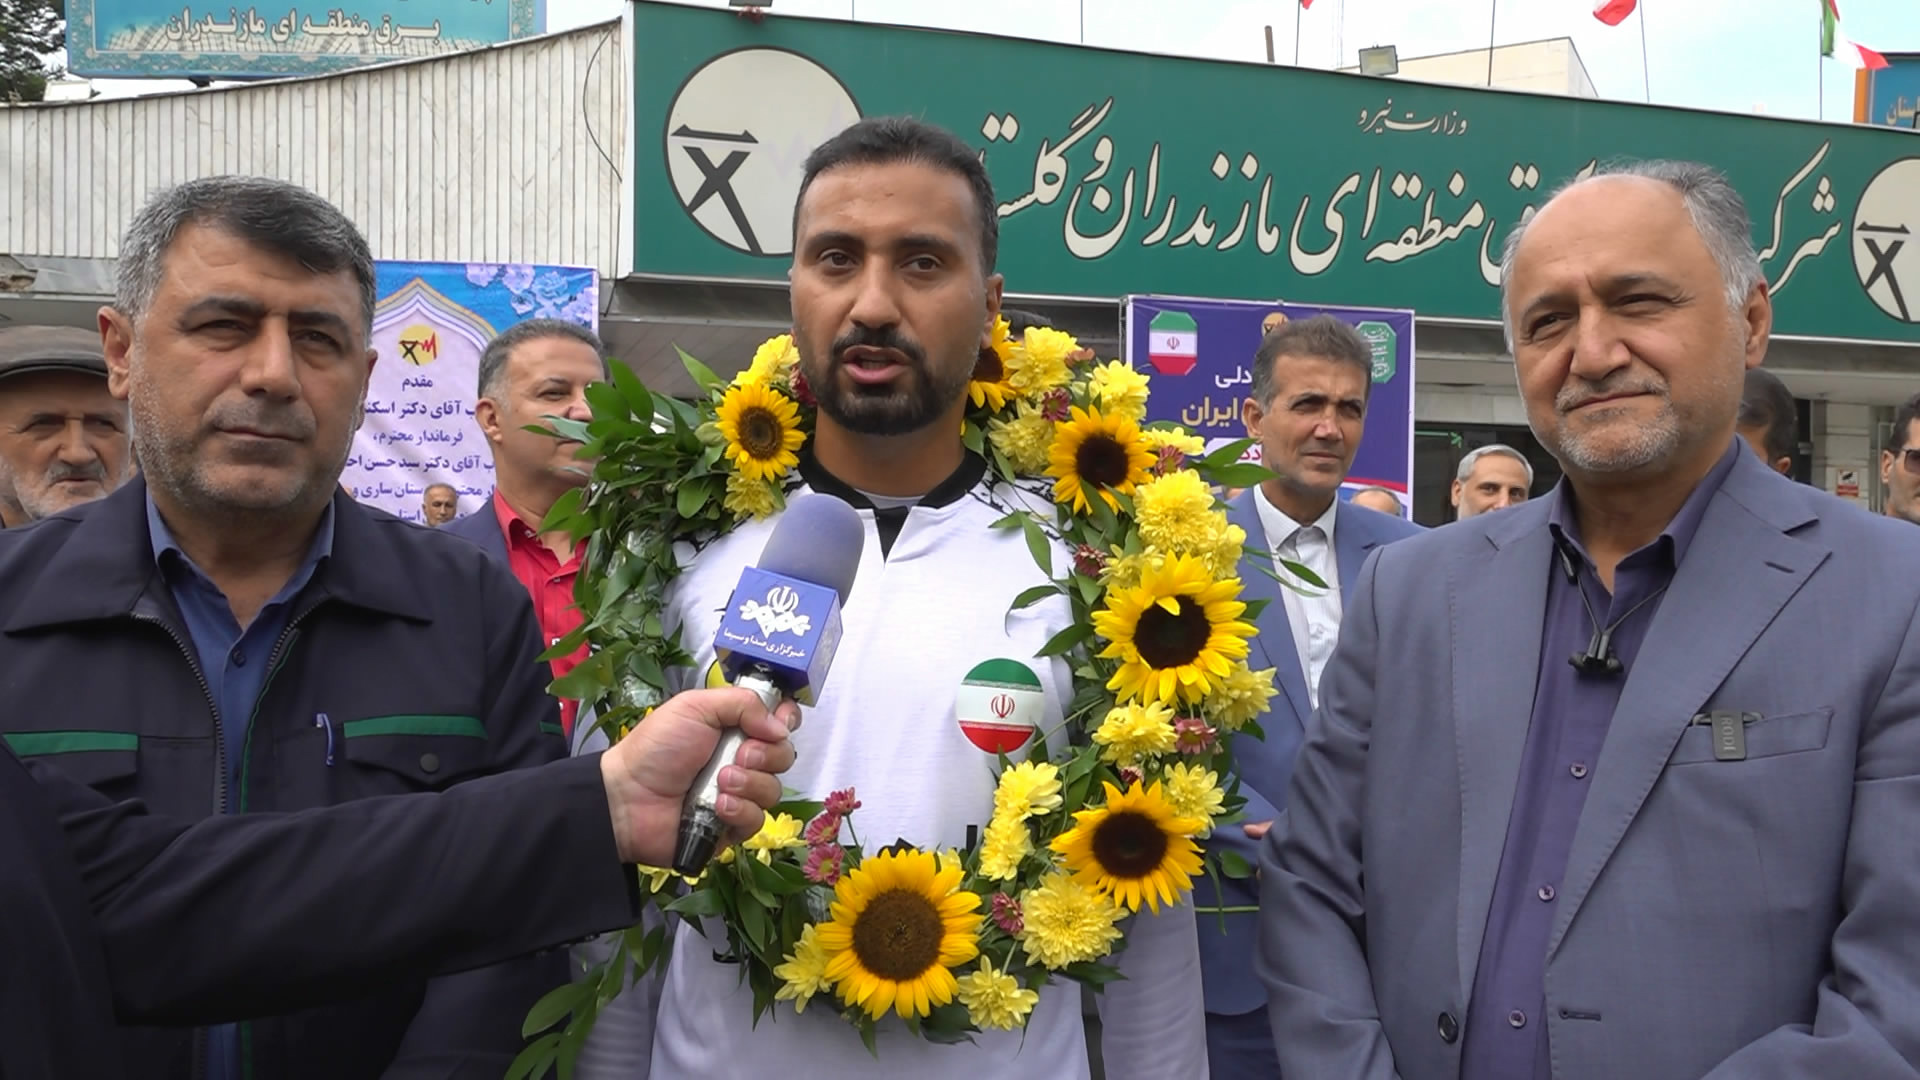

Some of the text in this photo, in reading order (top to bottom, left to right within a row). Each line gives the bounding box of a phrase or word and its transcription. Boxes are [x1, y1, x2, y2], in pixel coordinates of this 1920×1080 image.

[165, 7, 441, 46] برق منطقه ای مازندران
[1357, 98, 1468, 136] وزارت نیرو
[978, 96, 1114, 218] گلست
[1082, 135, 1114, 184] و
[1063, 143, 1280, 260] مازندران
[1289, 167, 1382, 276] ای
[1366, 170, 1486, 263] منطقه
[1756, 138, 1843, 297] شرک
[402, 374, 433, 391] مقدم
[1215, 366, 1252, 389] دلی
[365, 401, 395, 414] اسکن
[398, 402, 427, 419] دکتر
[430, 400, 462, 419] آقای
[1182, 396, 1238, 428] ایران
[416, 429, 463, 446] فرماندار
[364, 458, 396, 471] حسن
[398, 458, 420, 471] سید
[423, 456, 450, 472] دکتر
[452, 455, 481, 473] آقای
[361, 483, 392, 498] ساری
[394, 483, 423, 498] ستان
[750, 635, 768, 647] صدا
[766, 643, 806, 657] خبرگزاری
